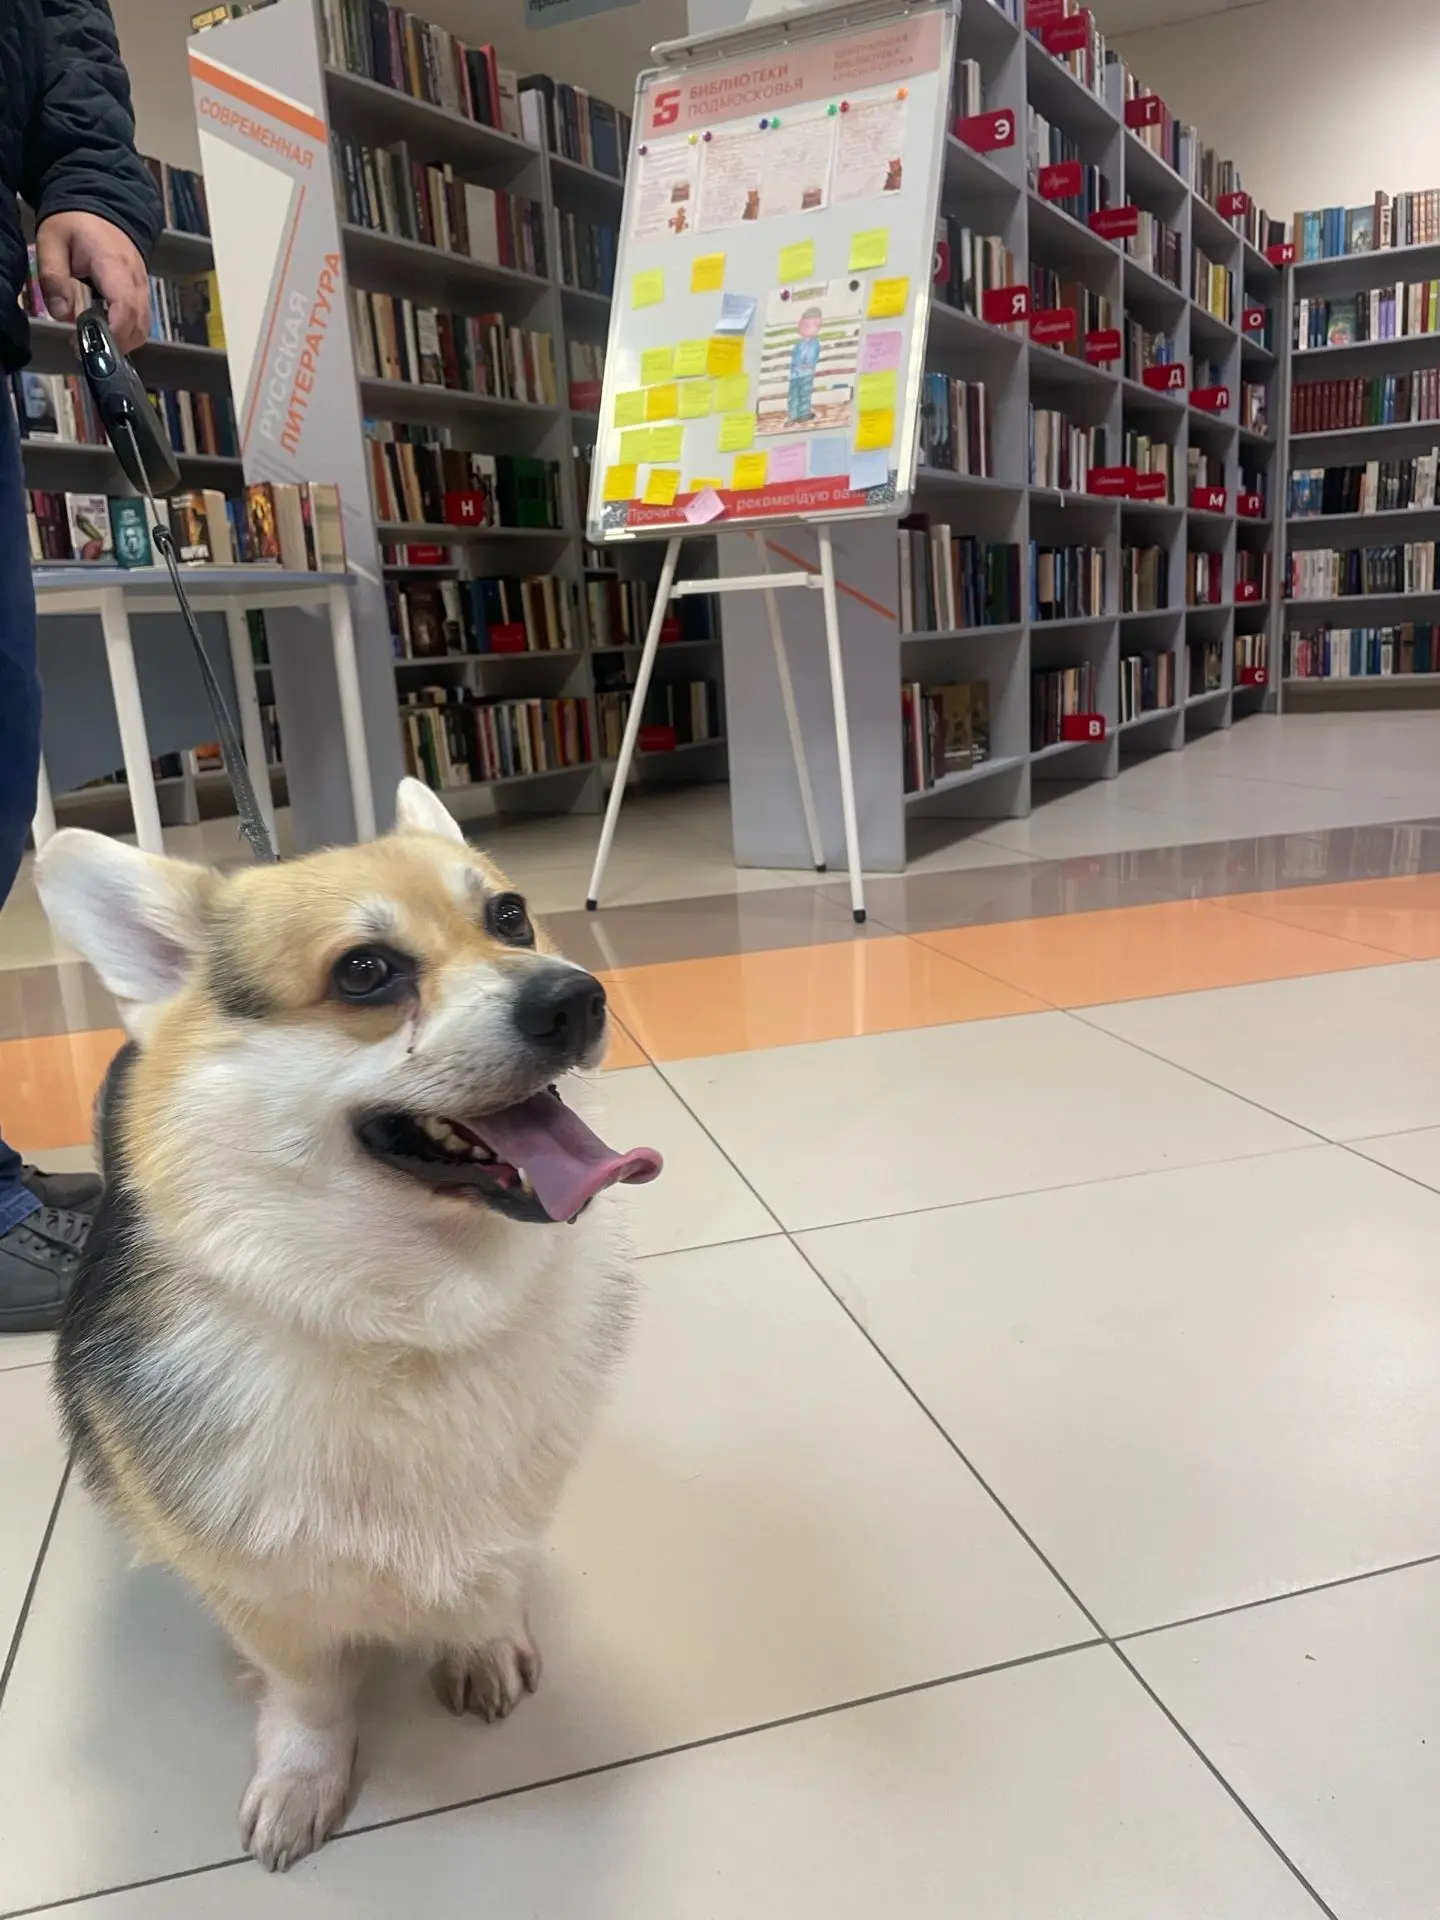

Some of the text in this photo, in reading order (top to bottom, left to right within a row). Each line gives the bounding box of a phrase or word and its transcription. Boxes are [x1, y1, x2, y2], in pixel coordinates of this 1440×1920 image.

[689, 63, 789, 100] БИБЛИОТЕКИ
[687, 77, 804, 117] ПОДМОСКОВЬЯ
[1146, 101, 1156, 119] Г
[200, 97, 315, 169] СОВРЕМЕННАЯ
[994, 118, 1010, 140] Э
[1231, 195, 1243, 211] К
[1282, 247, 1293, 261] Н
[1012, 293, 1026, 315] Я
[1249, 312, 1262, 326] О
[280, 253, 342, 457] ЛИТЕРАТУРА
[258, 291, 309, 441] РУССКАЯ
[1167, 368, 1182, 388] Д
[1215, 391, 1228, 407] Л
[461, 499, 474, 517] Н
[736, 490, 829, 513] рекомендую
[1209, 493, 1224, 507] М
[1248, 496, 1259, 510] П
[1244, 586, 1254, 598] Р
[1254, 670, 1265, 683] С
[1089, 719, 1101, 737] В
